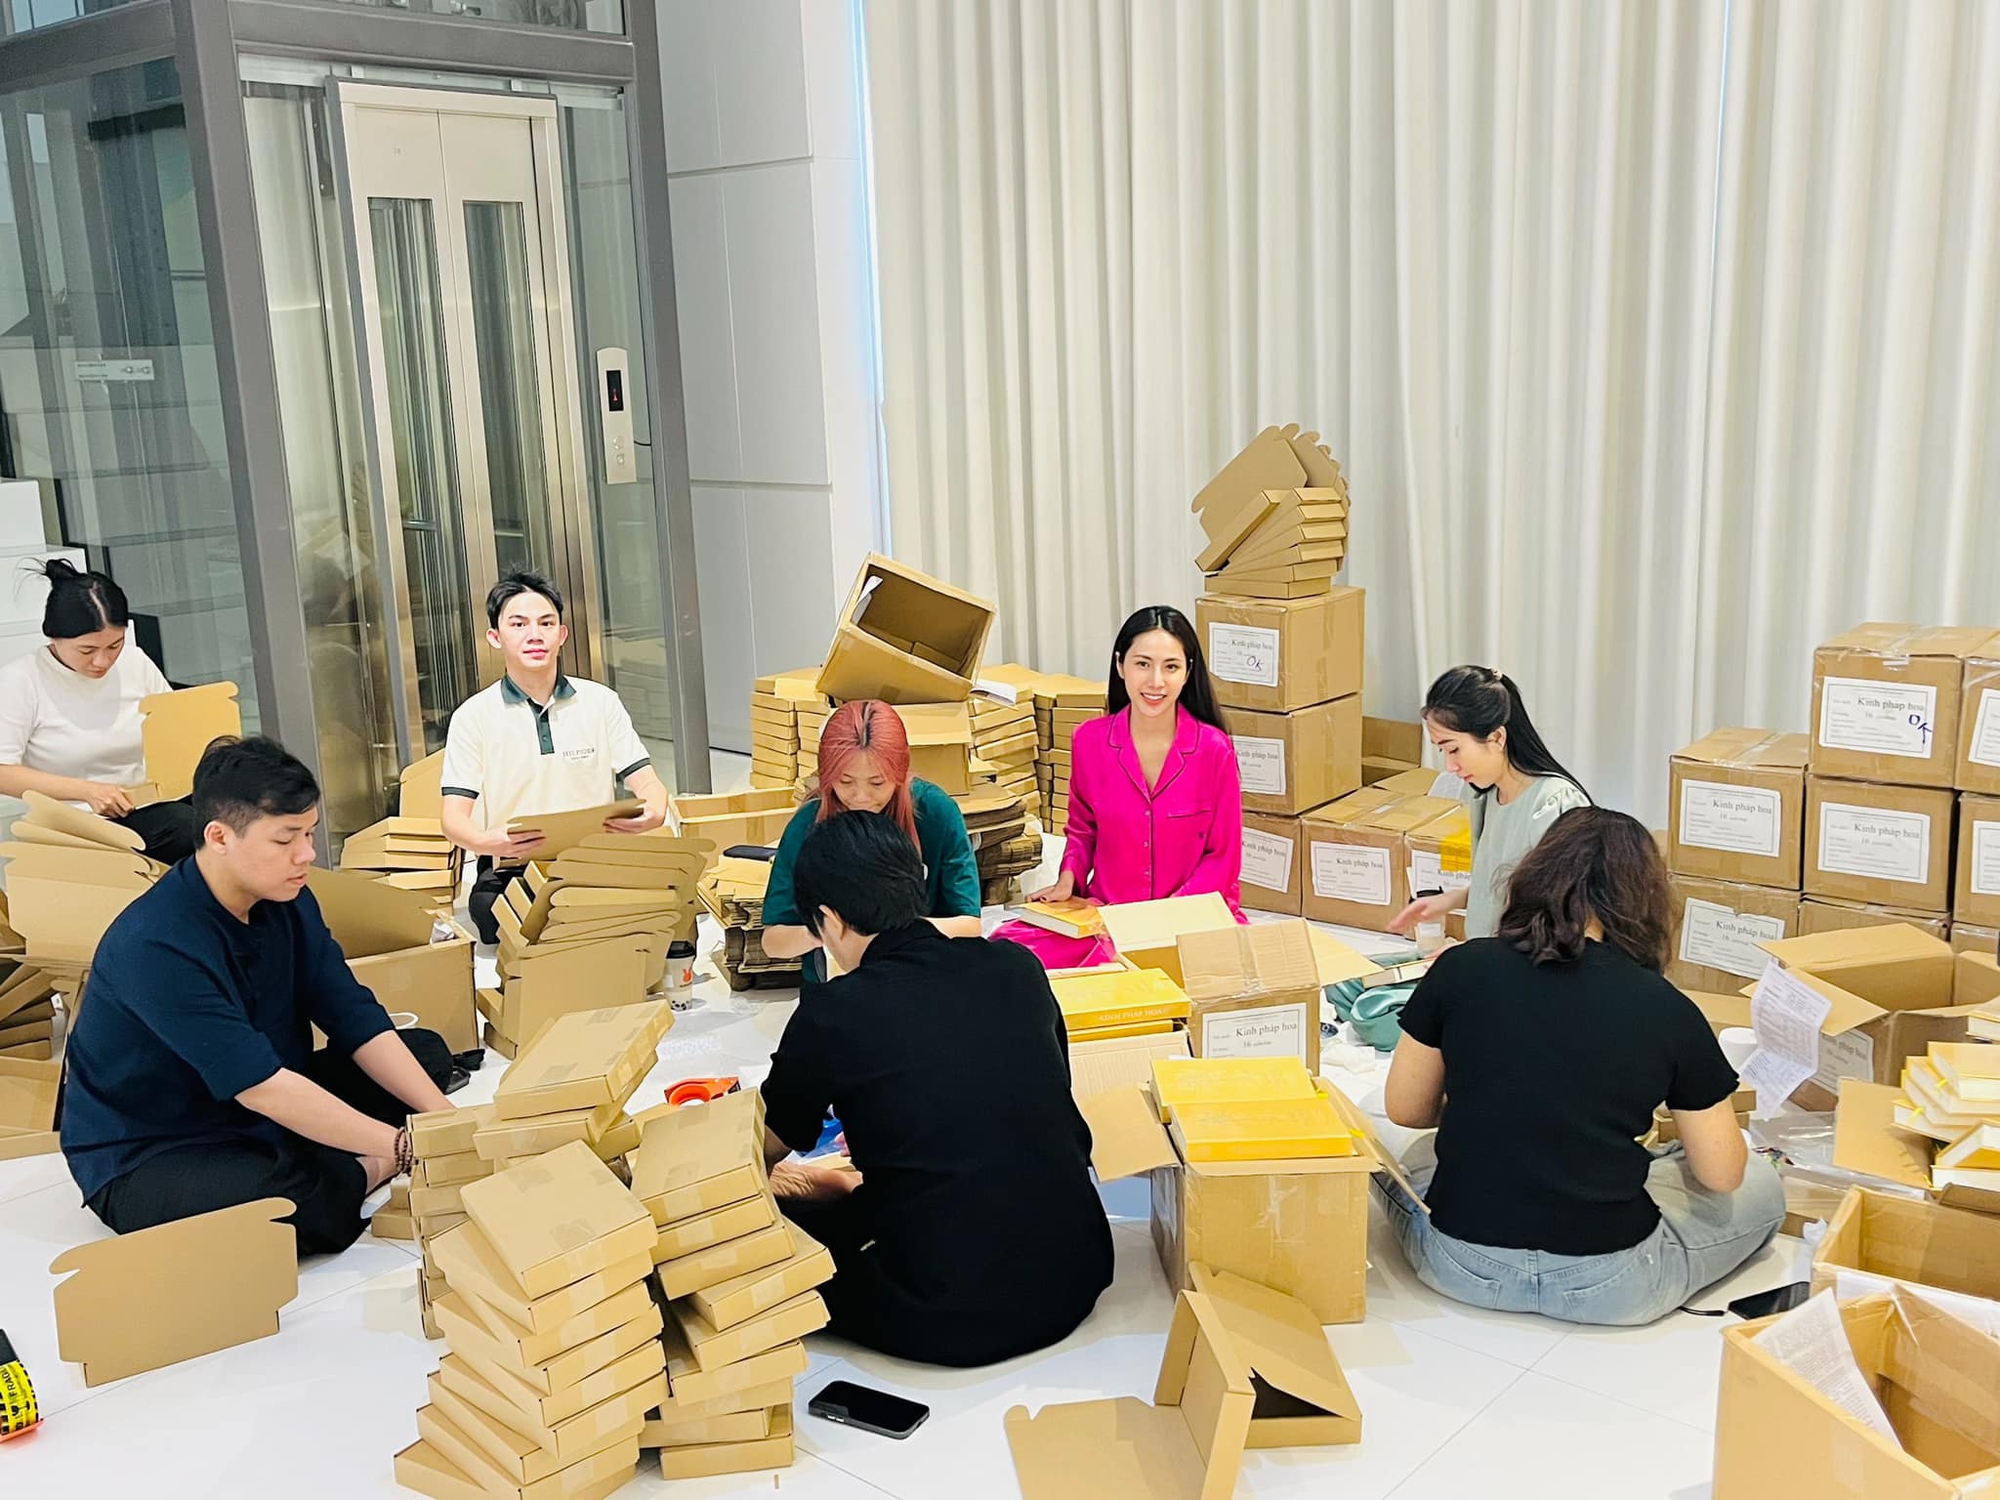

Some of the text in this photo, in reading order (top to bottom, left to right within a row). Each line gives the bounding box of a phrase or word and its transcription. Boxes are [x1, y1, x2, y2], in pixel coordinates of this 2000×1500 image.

[1246, 655, 1264, 671] OK
[1857, 696, 1881, 708] Kinh
[1712, 799, 1734, 810] Kinh
[1757, 804, 1773, 815] hoa
[1853, 823, 1877, 835] Kinh
[1902, 829, 1920, 839] hoa
[1716, 920, 1737, 932] Kinh
[1235, 1027, 1257, 1037] Kinh
[1259, 1023, 1280, 1036] pháp
[1281, 1022, 1298, 1031] hoa
